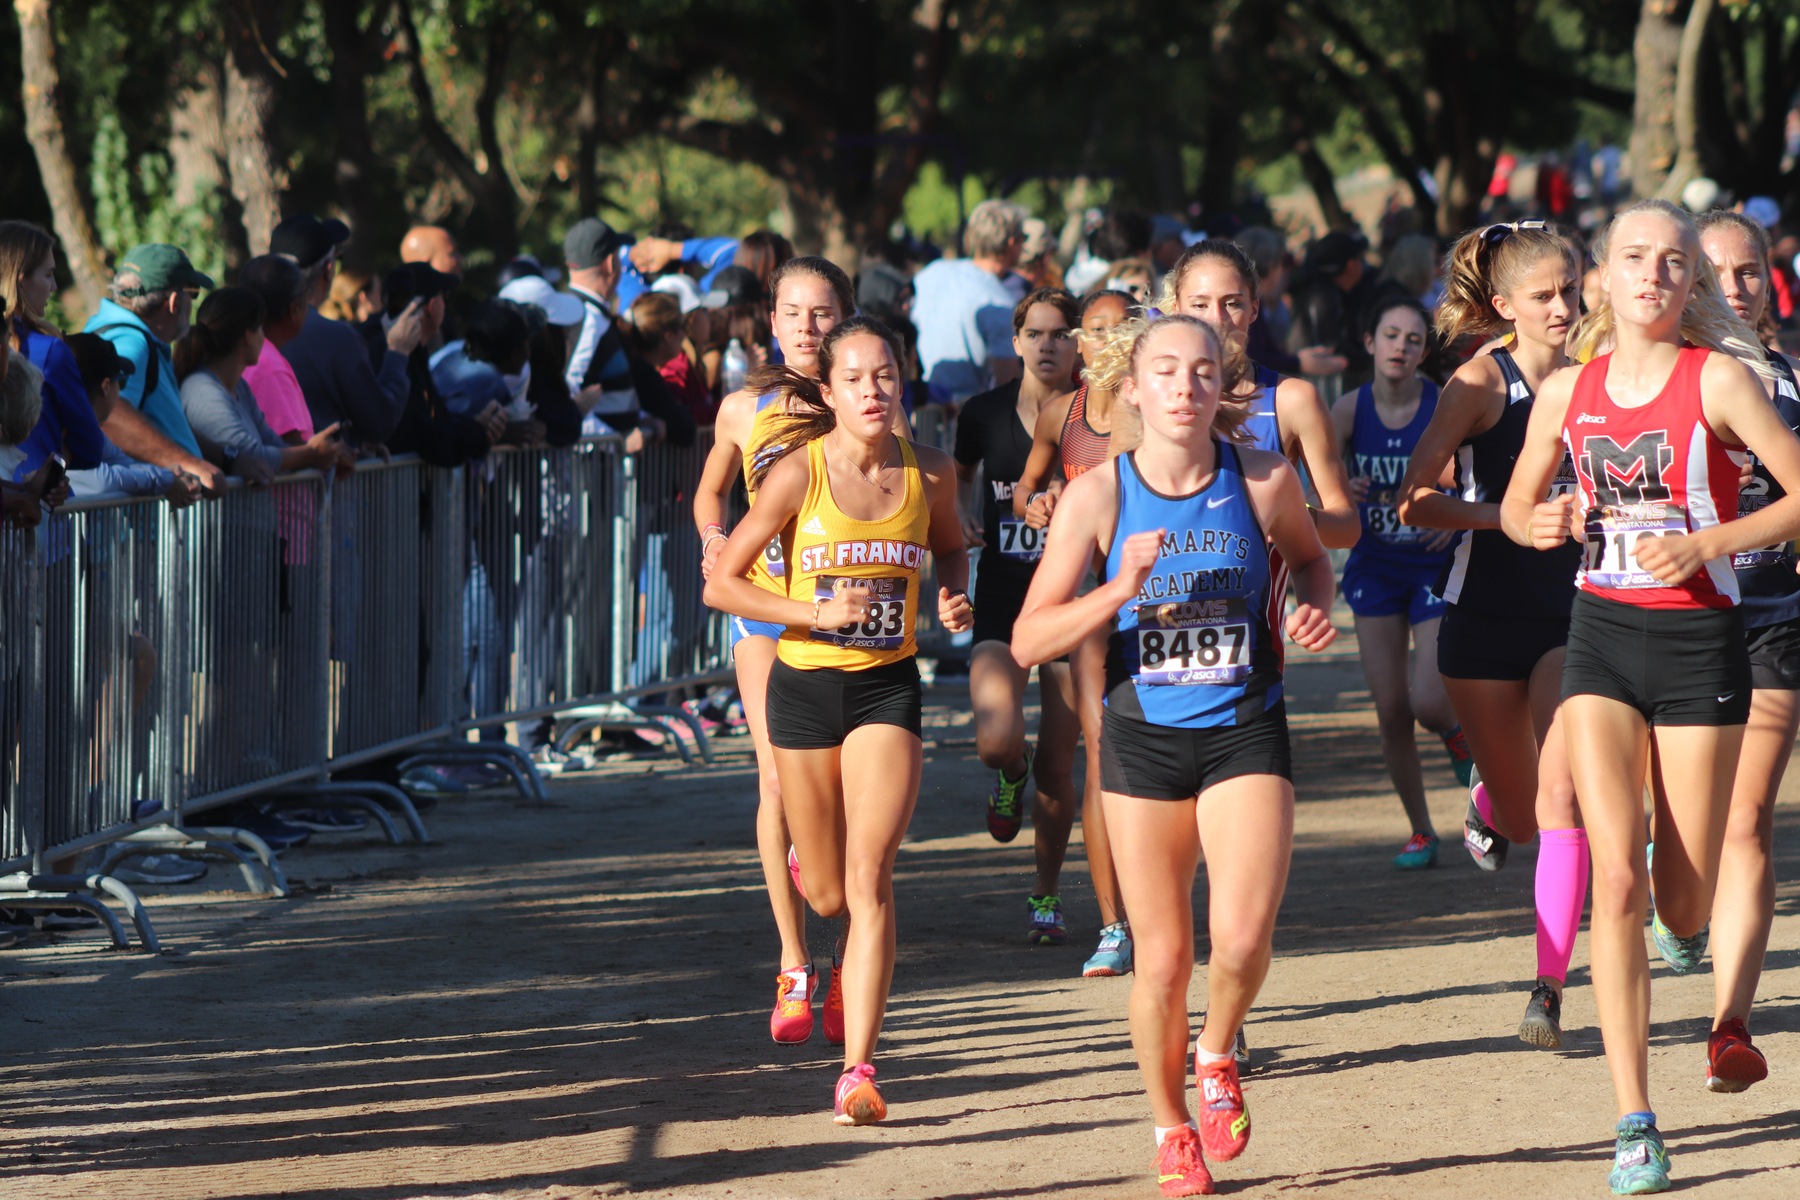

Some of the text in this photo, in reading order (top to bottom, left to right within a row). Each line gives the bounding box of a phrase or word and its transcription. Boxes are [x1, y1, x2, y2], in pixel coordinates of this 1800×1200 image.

[1578, 430, 1674, 506] M
[1370, 508, 1418, 533] 89
[1602, 504, 1667, 521] CLOVIS
[801, 544, 832, 573] ST.
[1160, 529, 1250, 560] MARY'S
[1586, 530, 1687, 572] 71
[1137, 566, 1247, 602] ACADEMY
[1157, 600, 1229, 619] CLOVIS
[1177, 616, 1227, 627] INVITATIONAL
[1141, 625, 1246, 670] 8487
